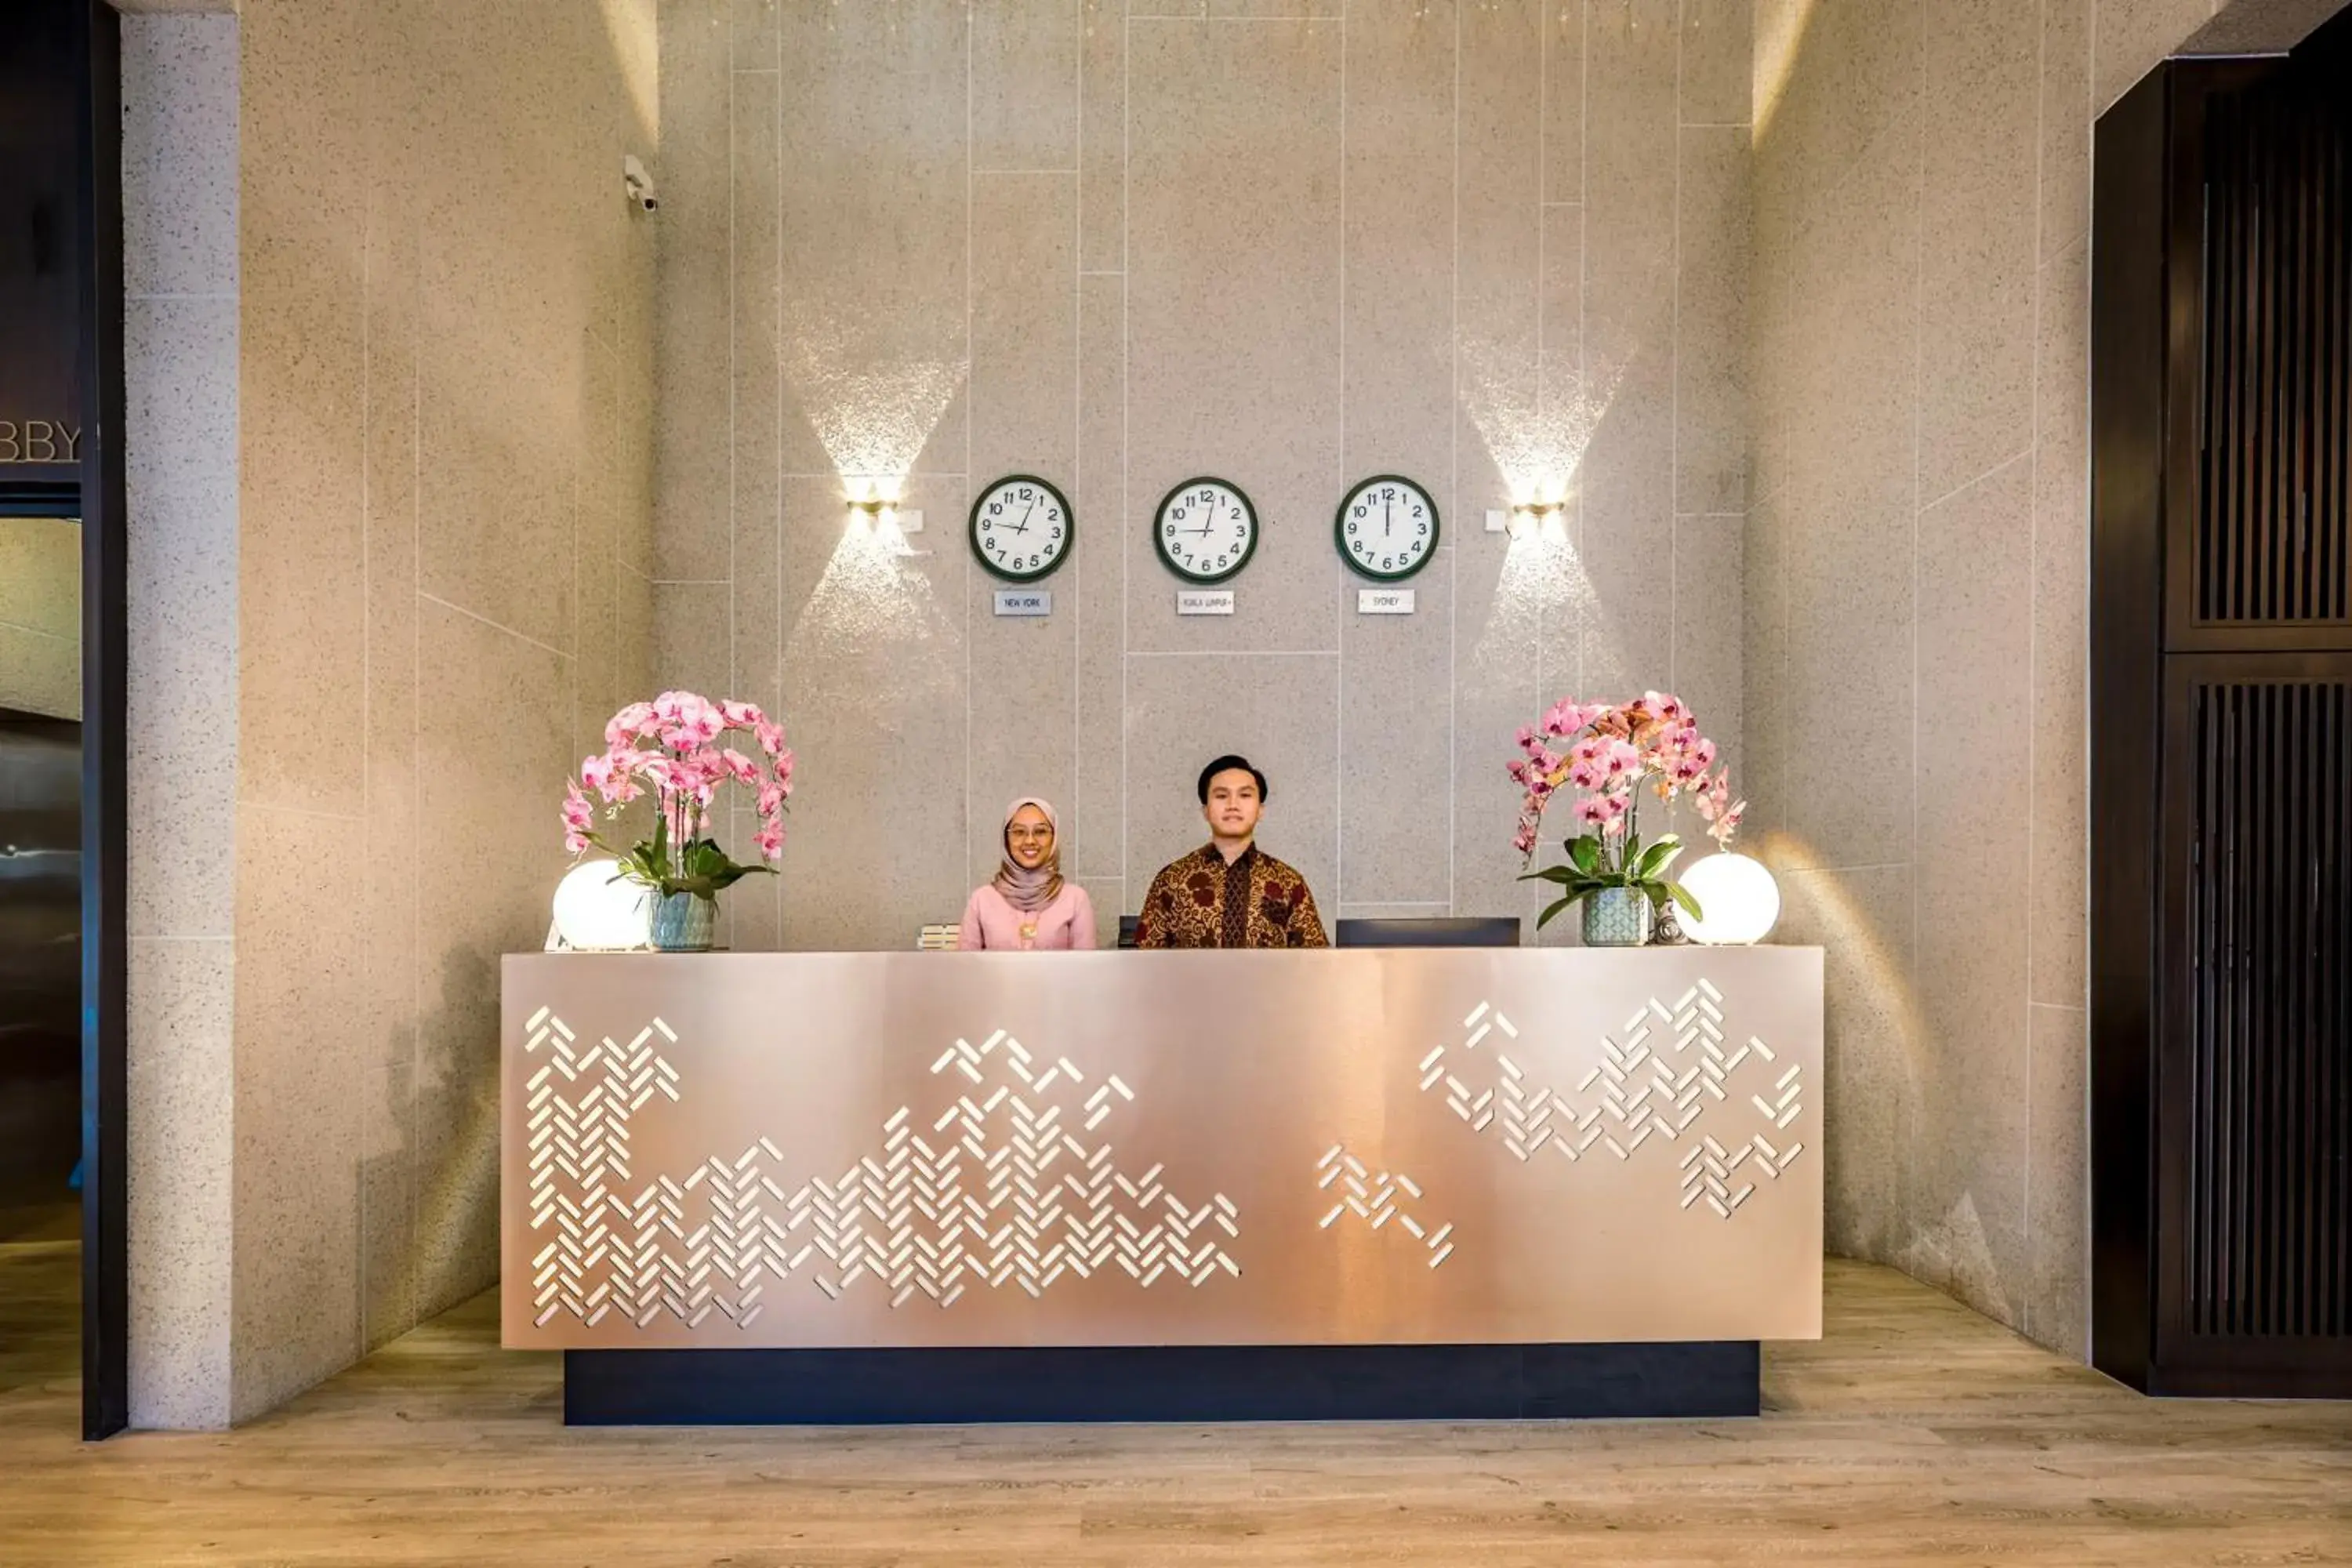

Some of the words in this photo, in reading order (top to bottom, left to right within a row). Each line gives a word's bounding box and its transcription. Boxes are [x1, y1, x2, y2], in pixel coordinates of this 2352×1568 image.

[1004, 492, 1014, 504] 11
[1019, 488, 1032, 500] 12
[1200, 491, 1214, 502] 12
[1367, 493, 1377, 505] 11
[1381, 488, 1395, 500] 12
[1403, 493, 1406, 504] 1
[1040, 495, 1044, 506] 1
[1185, 495, 1195, 507] 11
[1221, 495, 1225, 506] 1
[989, 503, 1002, 514] 10
[1172, 508, 1185, 520] 10
[1231, 508, 1240, 519] 2
[1354, 506, 1367, 517] 10
[1413, 506, 1421, 517] 2
[1047, 509, 1057, 521] 2
[982, 519, 991, 530] 9
[1348, 523, 1356, 534] 9
[1417, 524, 1426, 535] 3
[1051, 527, 1060, 539] 3
[1167, 525, 1175, 536] 9
[1236, 525, 1245, 537] 3
[985, 538, 995, 549] 8
[1172, 543, 1181, 554] 8
[1230, 543, 1240, 554] 4
[1353, 541, 1363, 552] 8
[1411, 541, 1421, 552] 4
[1044, 544, 1053, 555] 4
[997, 550, 1006, 562] 7
[1030, 555, 1039, 566] 5
[1185, 554, 1193, 566] 7
[1218, 555, 1226, 567] 5
[1366, 552, 1374, 563] 7
[1399, 554, 1408, 564] 5
[1014, 558, 1022, 569] 6
[1202, 560, 1210, 571] 6
[1383, 558, 1392, 569] 6
[1004, 598, 1020, 608] NEW
